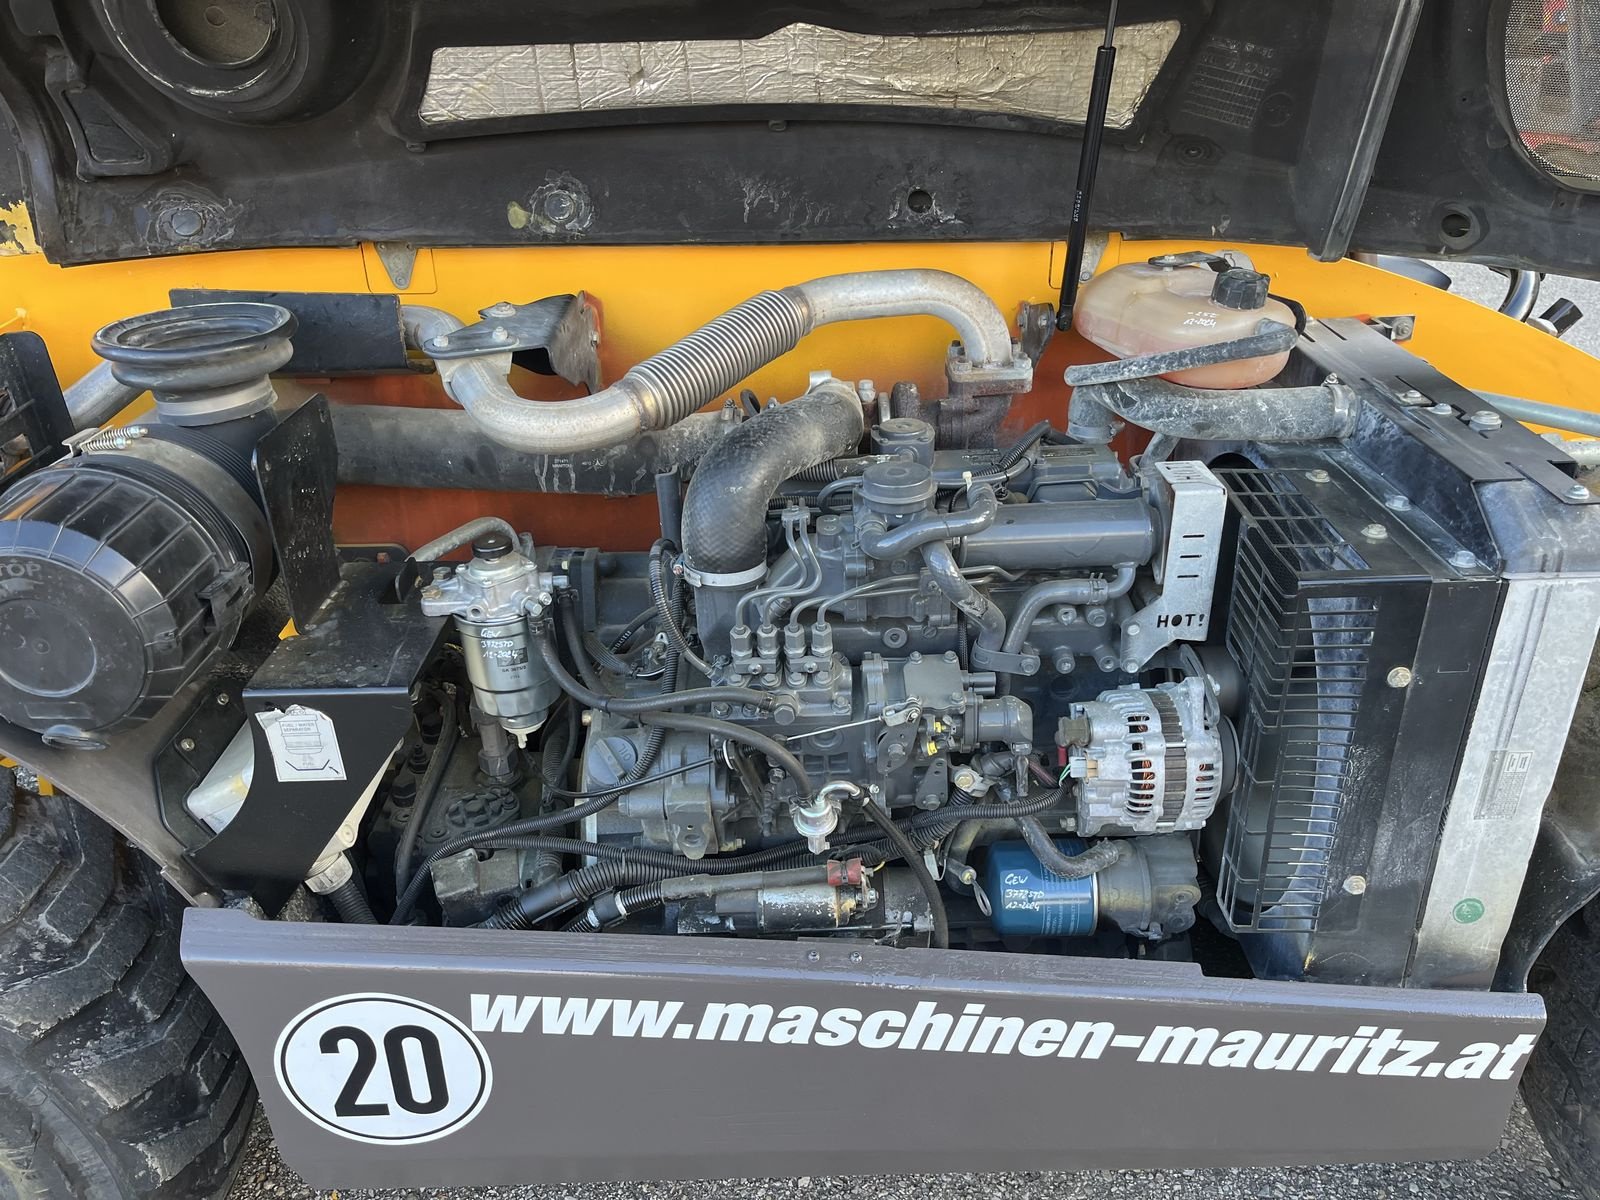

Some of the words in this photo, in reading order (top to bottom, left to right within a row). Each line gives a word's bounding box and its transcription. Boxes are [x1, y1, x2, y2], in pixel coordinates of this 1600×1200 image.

[1156, 613, 1205, 628] HOT!
[319, 1024, 449, 1117] 20
[470, 993, 1534, 1080] www.maschinen-mauritz.at
